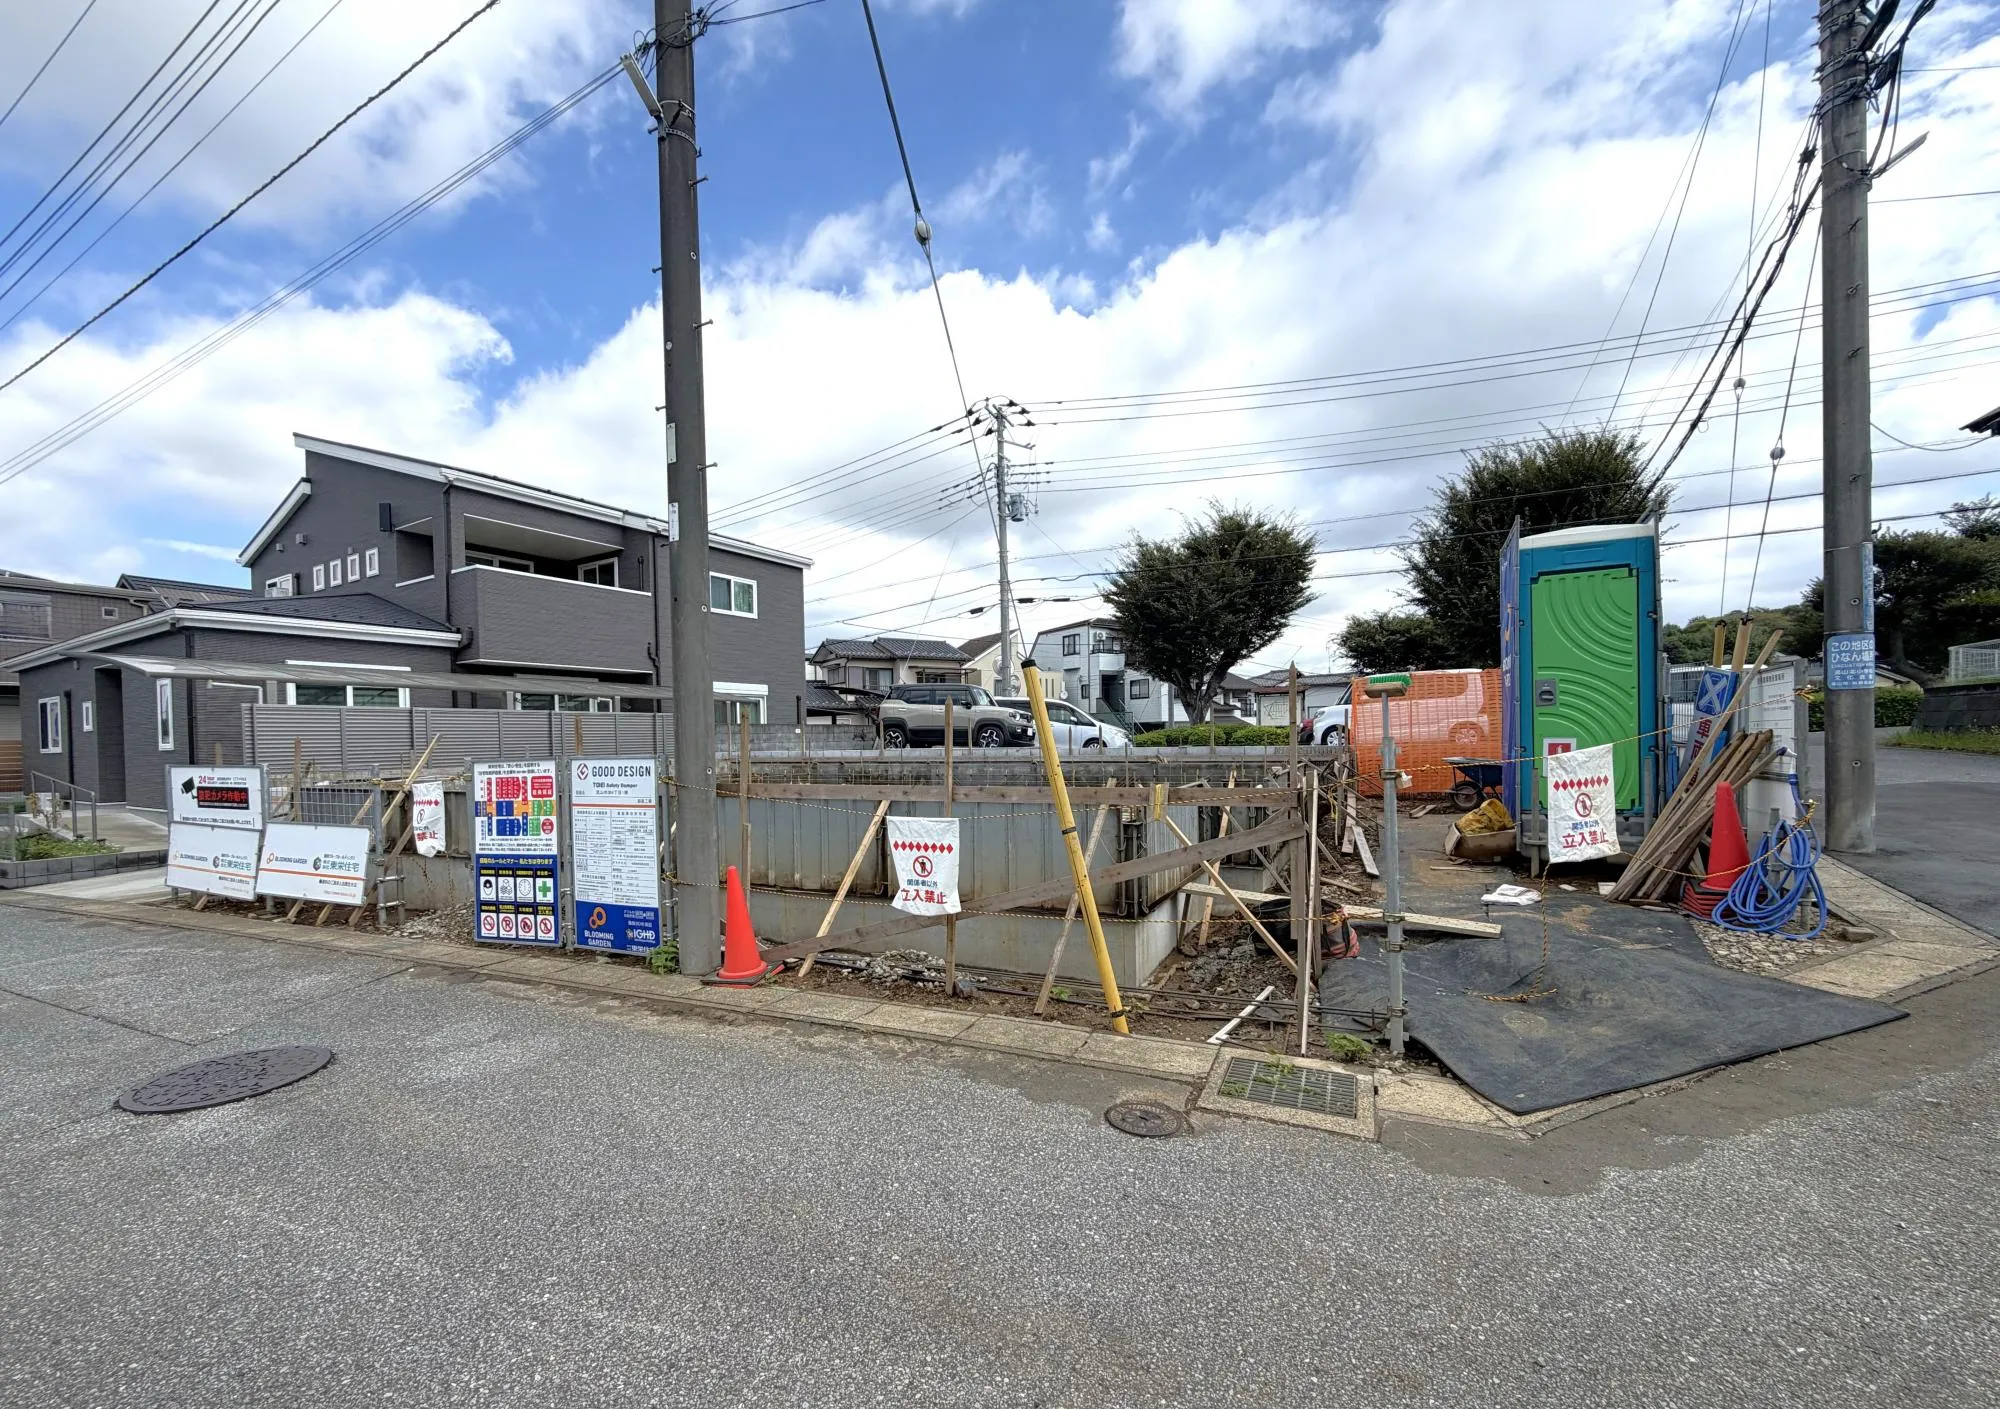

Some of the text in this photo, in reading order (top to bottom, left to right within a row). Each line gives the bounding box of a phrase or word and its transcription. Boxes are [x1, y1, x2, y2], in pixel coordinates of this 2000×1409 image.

[592, 766, 651, 777] GOOD DESIGN
[199, 776, 206, 785] 24
[1562, 828, 1609, 849] 立入禁止
[330, 860, 360, 872] 東栄住宅
[906, 879, 938, 888] 関係者以外
[901, 888, 948, 904] 立入禁止
[584, 930, 614, 940] BLOOMING
[588, 939, 612, 948] GARDEN
